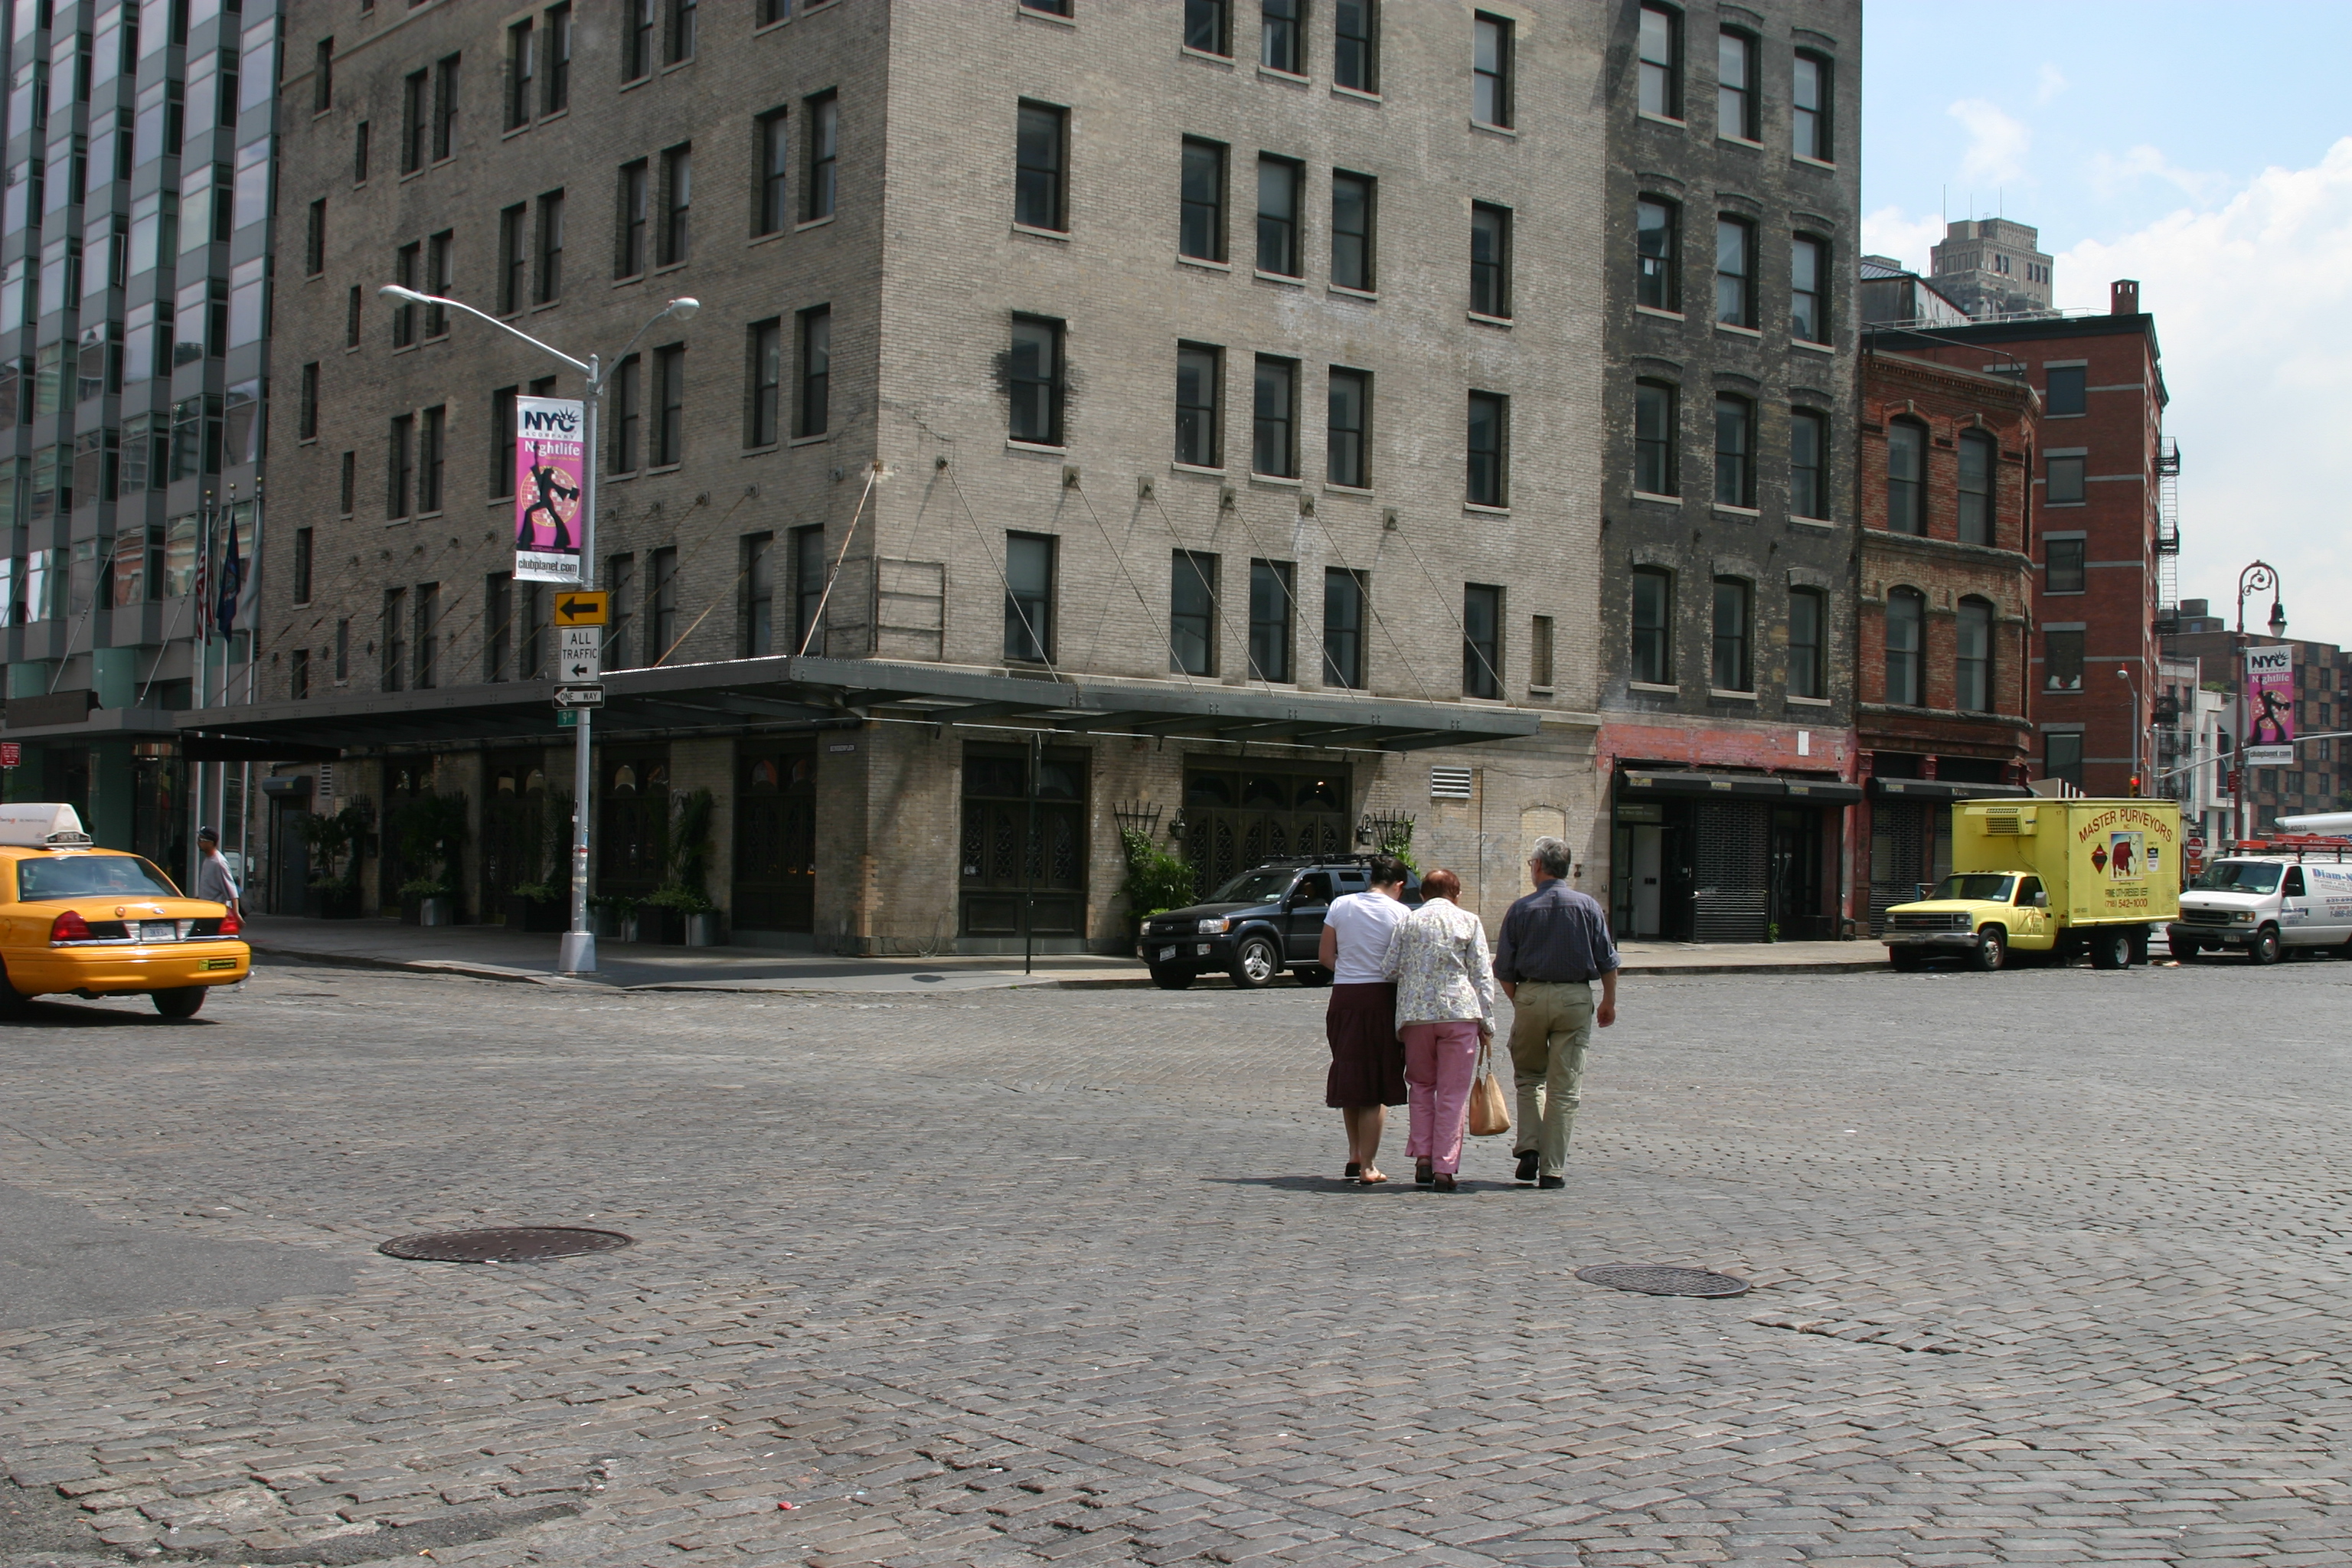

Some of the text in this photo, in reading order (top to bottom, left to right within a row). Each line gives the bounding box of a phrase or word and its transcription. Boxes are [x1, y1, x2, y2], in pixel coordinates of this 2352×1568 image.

[524, 406, 582, 433] NYC
[524, 440, 580, 457] Nghtlife
[518, 558, 577, 573] clubplanet.com
[570, 632, 591, 645] ALL
[563, 648, 597, 660] TRAFFIC
[2252, 650, 2289, 668] NYC
[2252, 674, 2290, 685] Nghtlife
[560, 692, 598, 701] ONE WAY
[562, 712, 568, 724] 9
[2078, 808, 2173, 844] MASTER PURVEYORS
[2118, 898, 2148, 908] 542-1000
